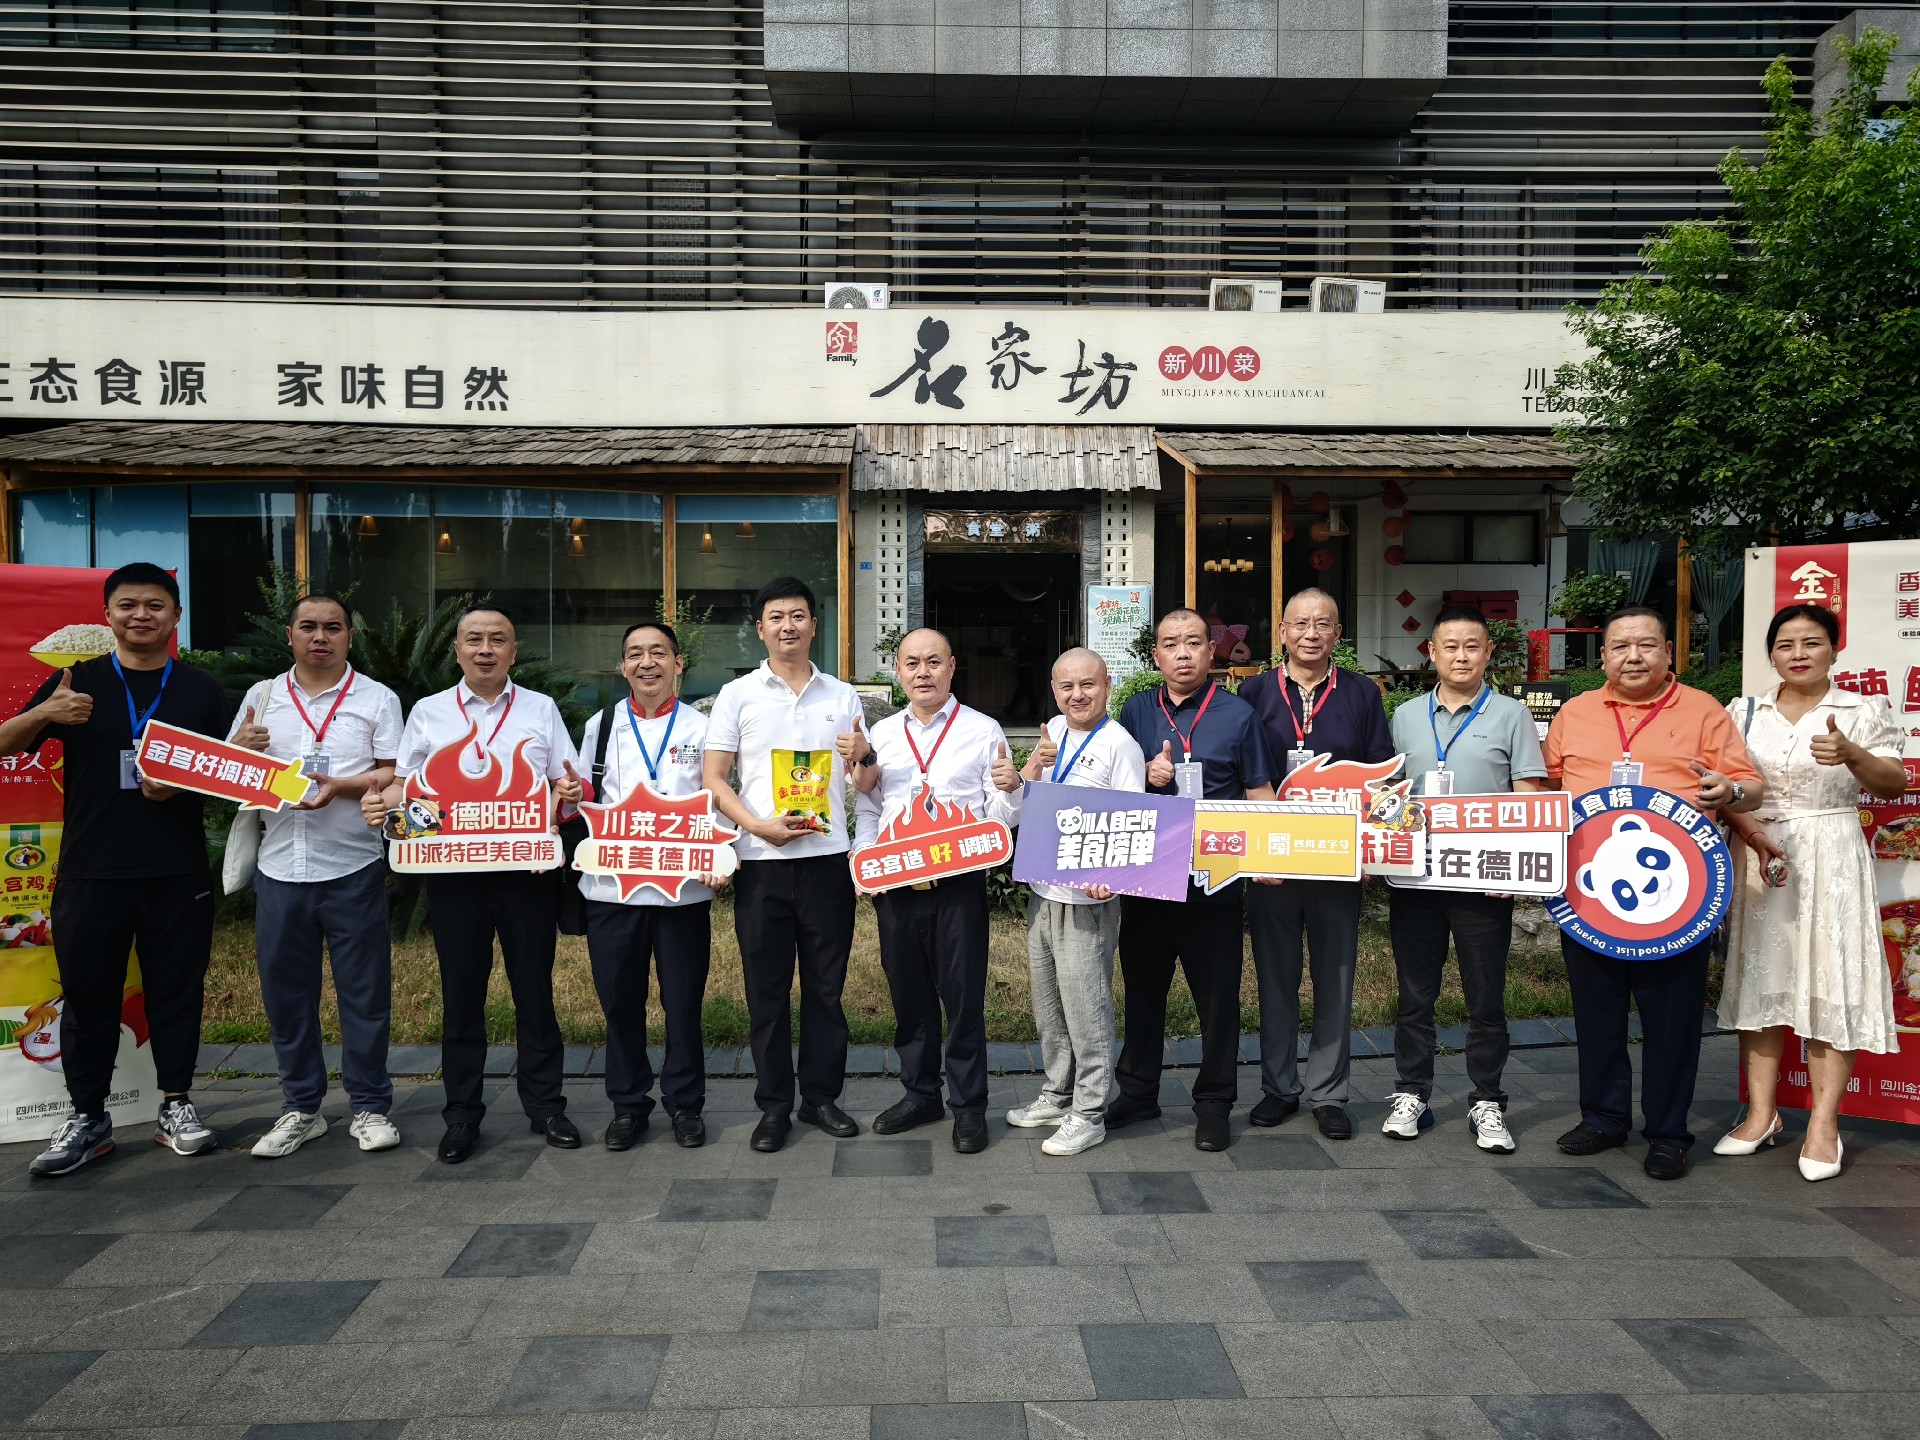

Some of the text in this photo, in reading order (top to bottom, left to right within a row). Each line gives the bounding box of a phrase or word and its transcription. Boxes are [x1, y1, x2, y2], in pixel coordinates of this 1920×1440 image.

[826, 354, 858, 366] Family
[870, 315, 1138, 416] 名家坊
[1162, 351, 1257, 376] 新川菜
[277, 361, 510, 412] 家味自然
[1161, 388, 1327, 398] MINGJIAFANG XINCHUANCAI
[144, 739, 268, 790] 金宫好调料
[450, 801, 541, 831] 德阳站
[601, 809, 714, 840] 川菜之源
[1080, 809, 1158, 833] 川人自己的
[1430, 800, 1562, 829] 食在四川
[1647, 792, 1720, 852] 德阳站
[397, 840, 555, 864] 川派特色美食榜
[598, 845, 714, 872] 味美德阳
[861, 831, 1003, 880] 金宫造 好 调料
[1056, 831, 1156, 870] 美食榜单
[1294, 840, 1350, 850] 四川老字号
[1425, 848, 1553, 882] 在德阳
[1570, 923, 1607, 949] Deyang
[1667, 920, 1711, 951] Specialty
[1615, 946, 1636, 957] List
[1639, 945, 1667, 957] Food
[1881, 1079, 1920, 1095] 四川金
